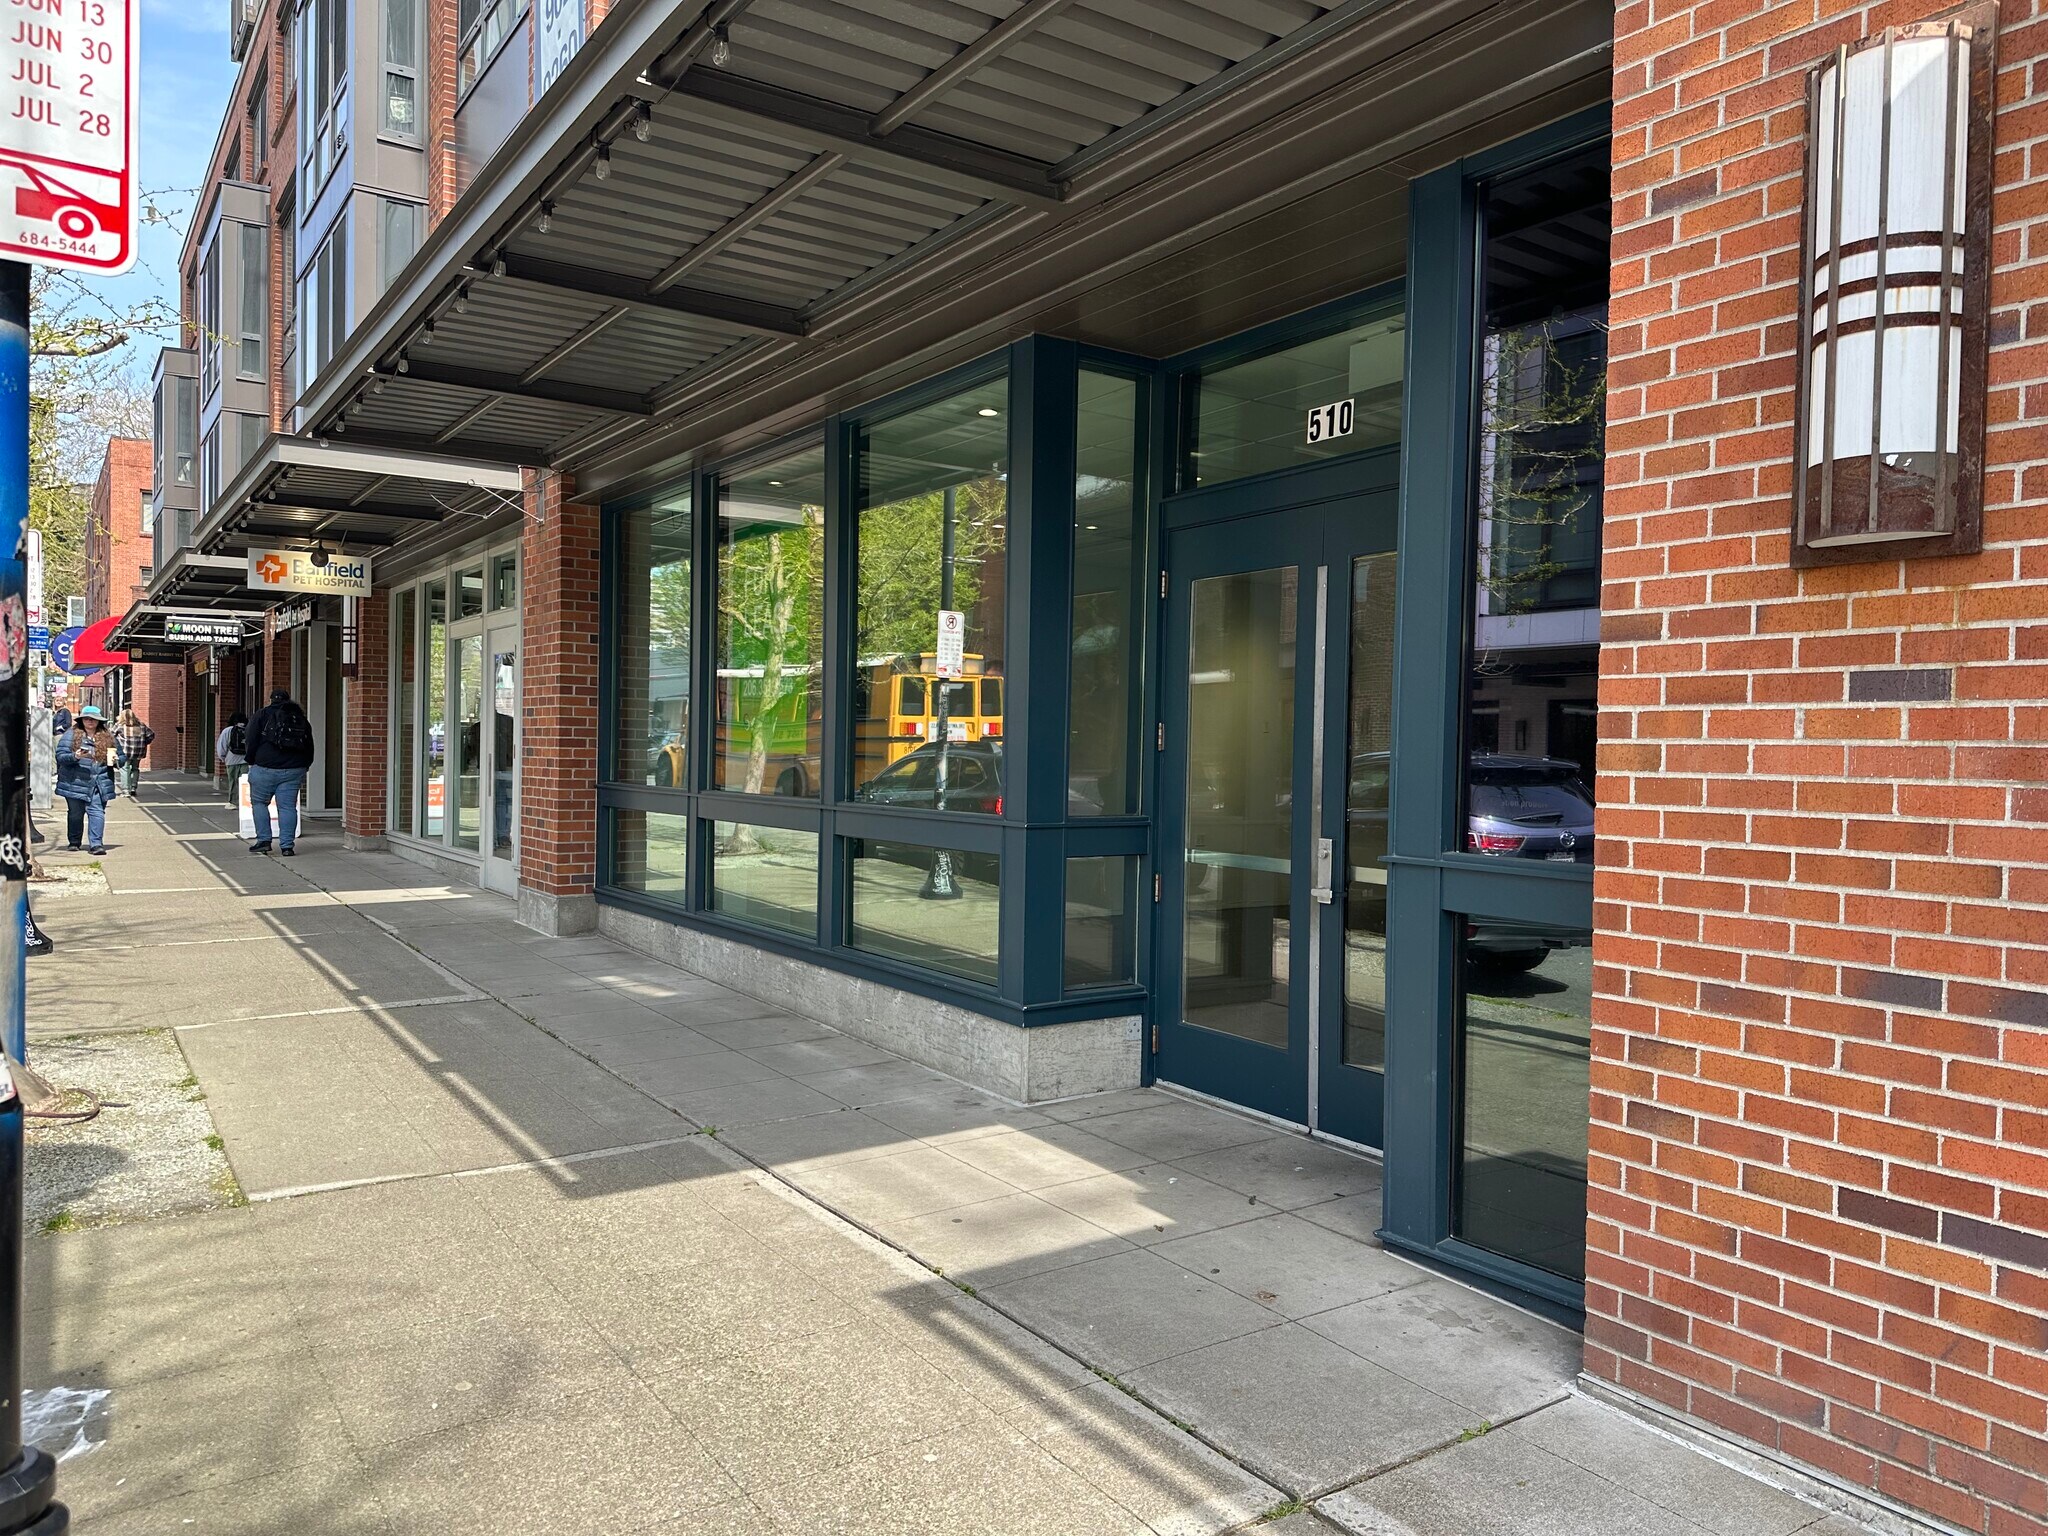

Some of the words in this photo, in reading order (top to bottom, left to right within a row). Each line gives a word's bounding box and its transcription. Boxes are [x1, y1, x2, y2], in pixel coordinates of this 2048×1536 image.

[81, 1, 105, 26] 13
[11, 21, 62, 53] JUN
[81, 37, 112, 64] 30
[11, 58, 61, 90] JUL
[79, 74, 94, 97] 2
[11, 96, 61, 127] JUL
[79, 110, 110, 137] 28
[19, 231, 96, 255] 684-5444
[1309, 401, 1352, 441] 510
[293, 576, 313, 585] PET
[315, 578, 365, 588] HOSPITAL
[168, 633, 194, 641] SUSHI
[195, 634, 212, 642] AND
[213, 636, 239, 644] TAPAS
[182, 624, 212, 635] MOON
[213, 625, 239, 635] TREE
